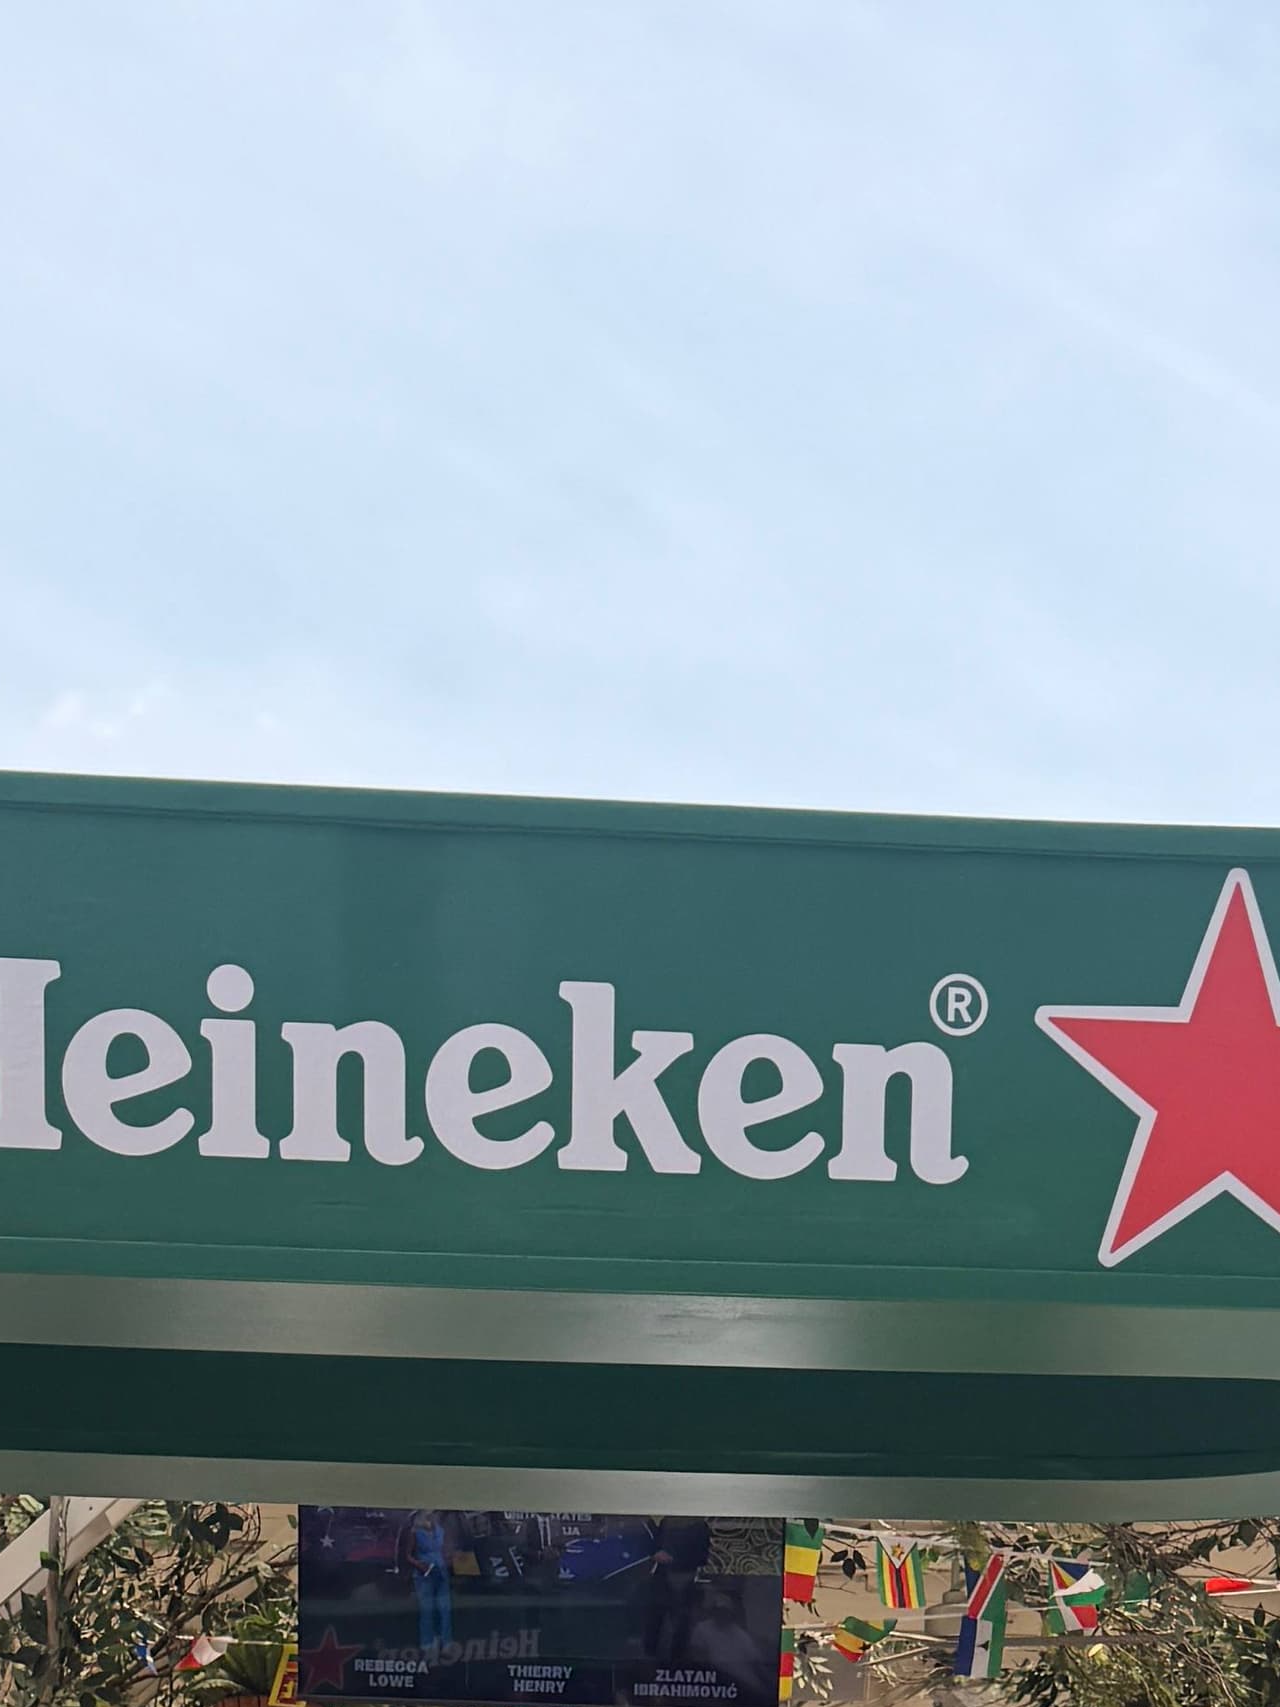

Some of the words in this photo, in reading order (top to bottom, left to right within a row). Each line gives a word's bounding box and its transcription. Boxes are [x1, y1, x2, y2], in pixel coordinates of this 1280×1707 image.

[354, 1659, 429, 1675] REBECCA
[507, 1664, 573, 1679] THIERRY
[369, 1673, 414, 1688] LOWE
[655, 1669, 716, 1683] ZLATAN
[513, 1679, 566, 1693] HENRY
[633, 1682, 738, 1699] IBRAHIMOVIĆ
